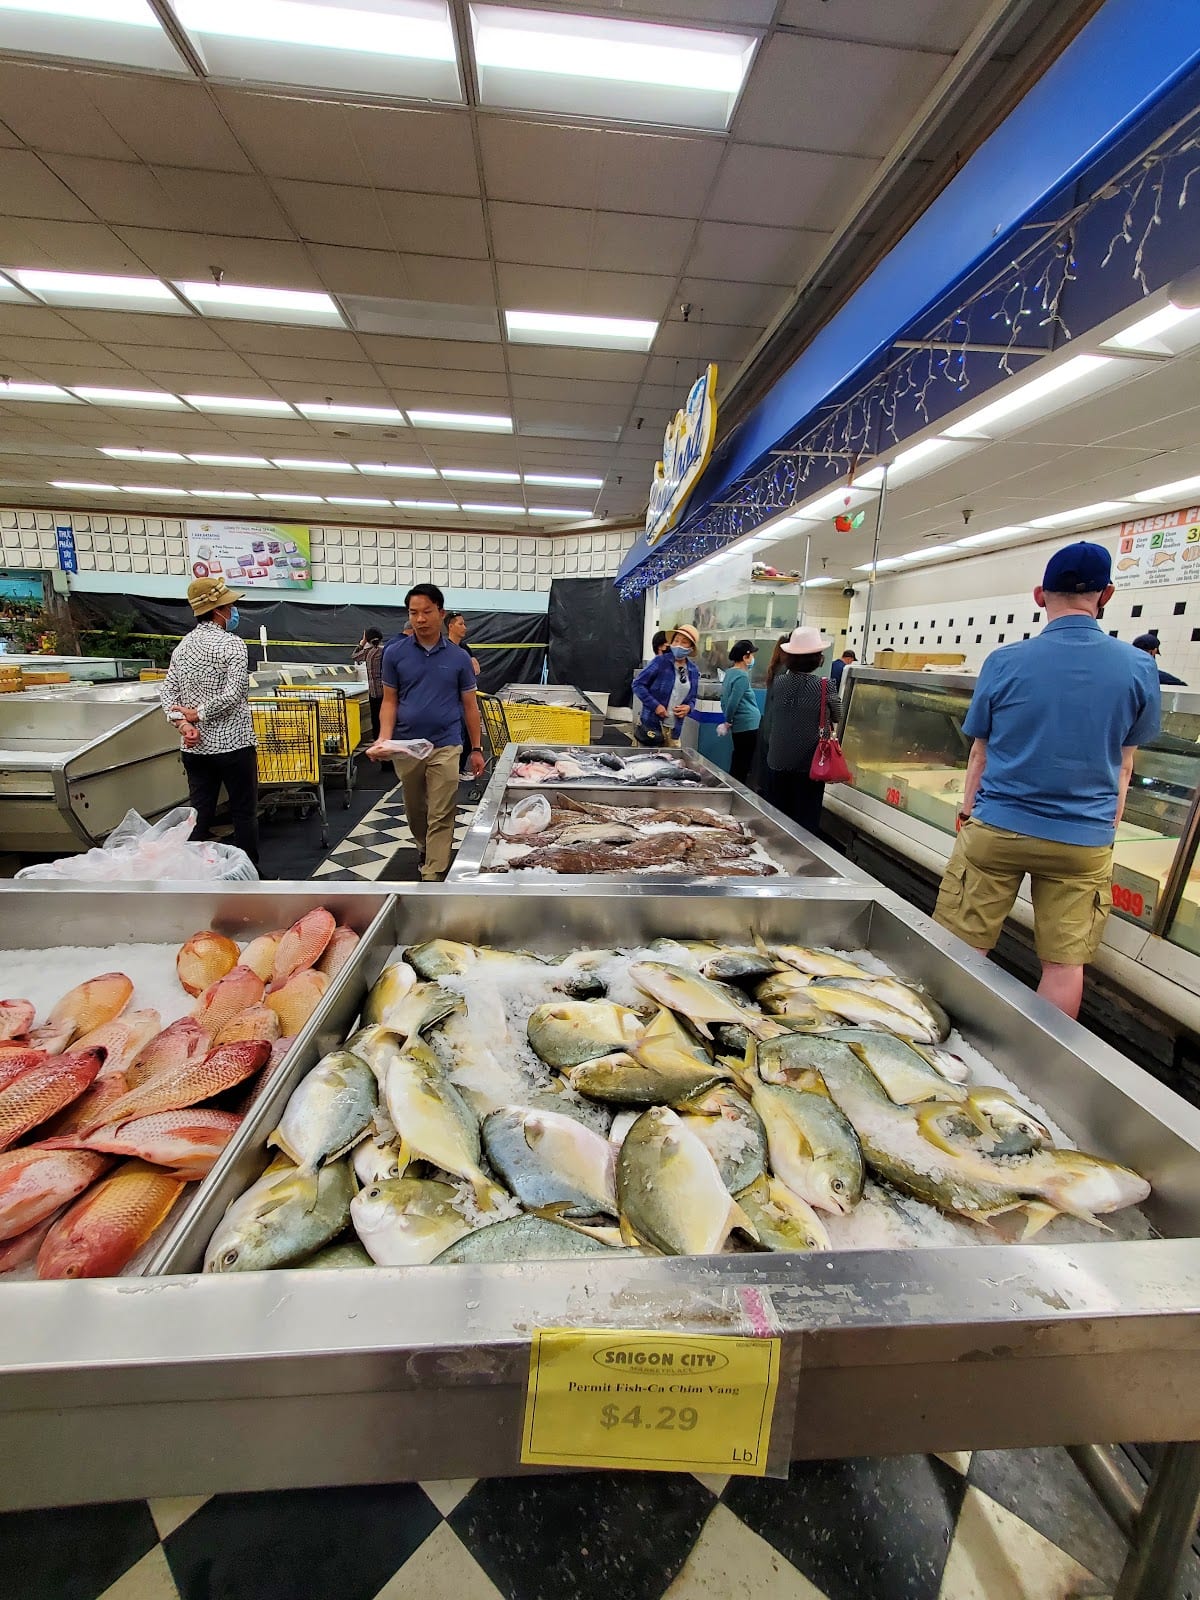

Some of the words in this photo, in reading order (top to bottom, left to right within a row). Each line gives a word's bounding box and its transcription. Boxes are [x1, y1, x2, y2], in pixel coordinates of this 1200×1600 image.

[1124, 511, 1180, 535] FRESH
[1151, 535, 1161, 545] 2
[1187, 528, 1198, 540] 3
[604, 1351, 674, 1366] SAIGON
[680, 1354, 717, 1367] CITY
[568, 1381, 611, 1392] Permit
[616, 1383, 665, 1393] Fish-Ca
[669, 1384, 703, 1393] Chim
[707, 1385, 740, 1396] Vang
[600, 1403, 698, 1431] $4.29
[732, 1448, 753, 1462] Lb
